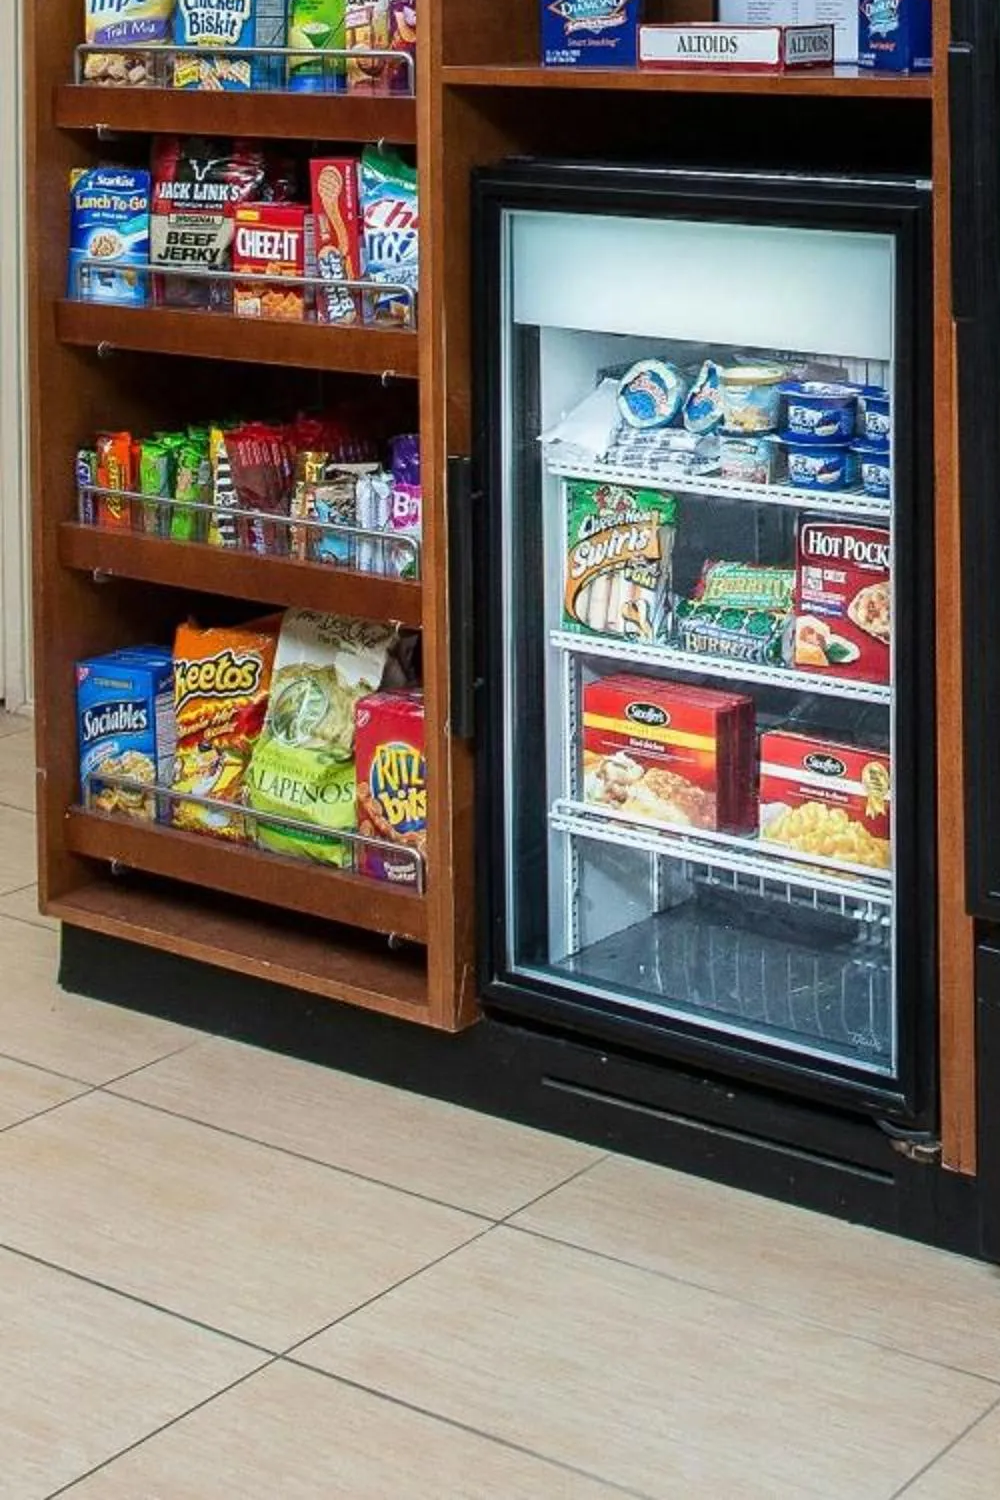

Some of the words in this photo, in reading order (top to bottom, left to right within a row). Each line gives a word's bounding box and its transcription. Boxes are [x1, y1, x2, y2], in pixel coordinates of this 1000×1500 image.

[189, 11, 237, 37] Biskit
[677, 36, 738, 54] ALTOIDS
[76, 196, 111, 210] Lunch
[159, 182, 191, 199] JACK
[193, 183, 240, 203] LINK'S
[166, 231, 218, 247] BEEF
[236, 227, 299, 262] CHEEZ-IT
[158, 247, 221, 263] JERKY
[570, 528, 649, 571] Swirls
[809, 530, 843, 556] HOT
[845, 536, 889, 566] POCK
[84, 707, 147, 741] Sociables
